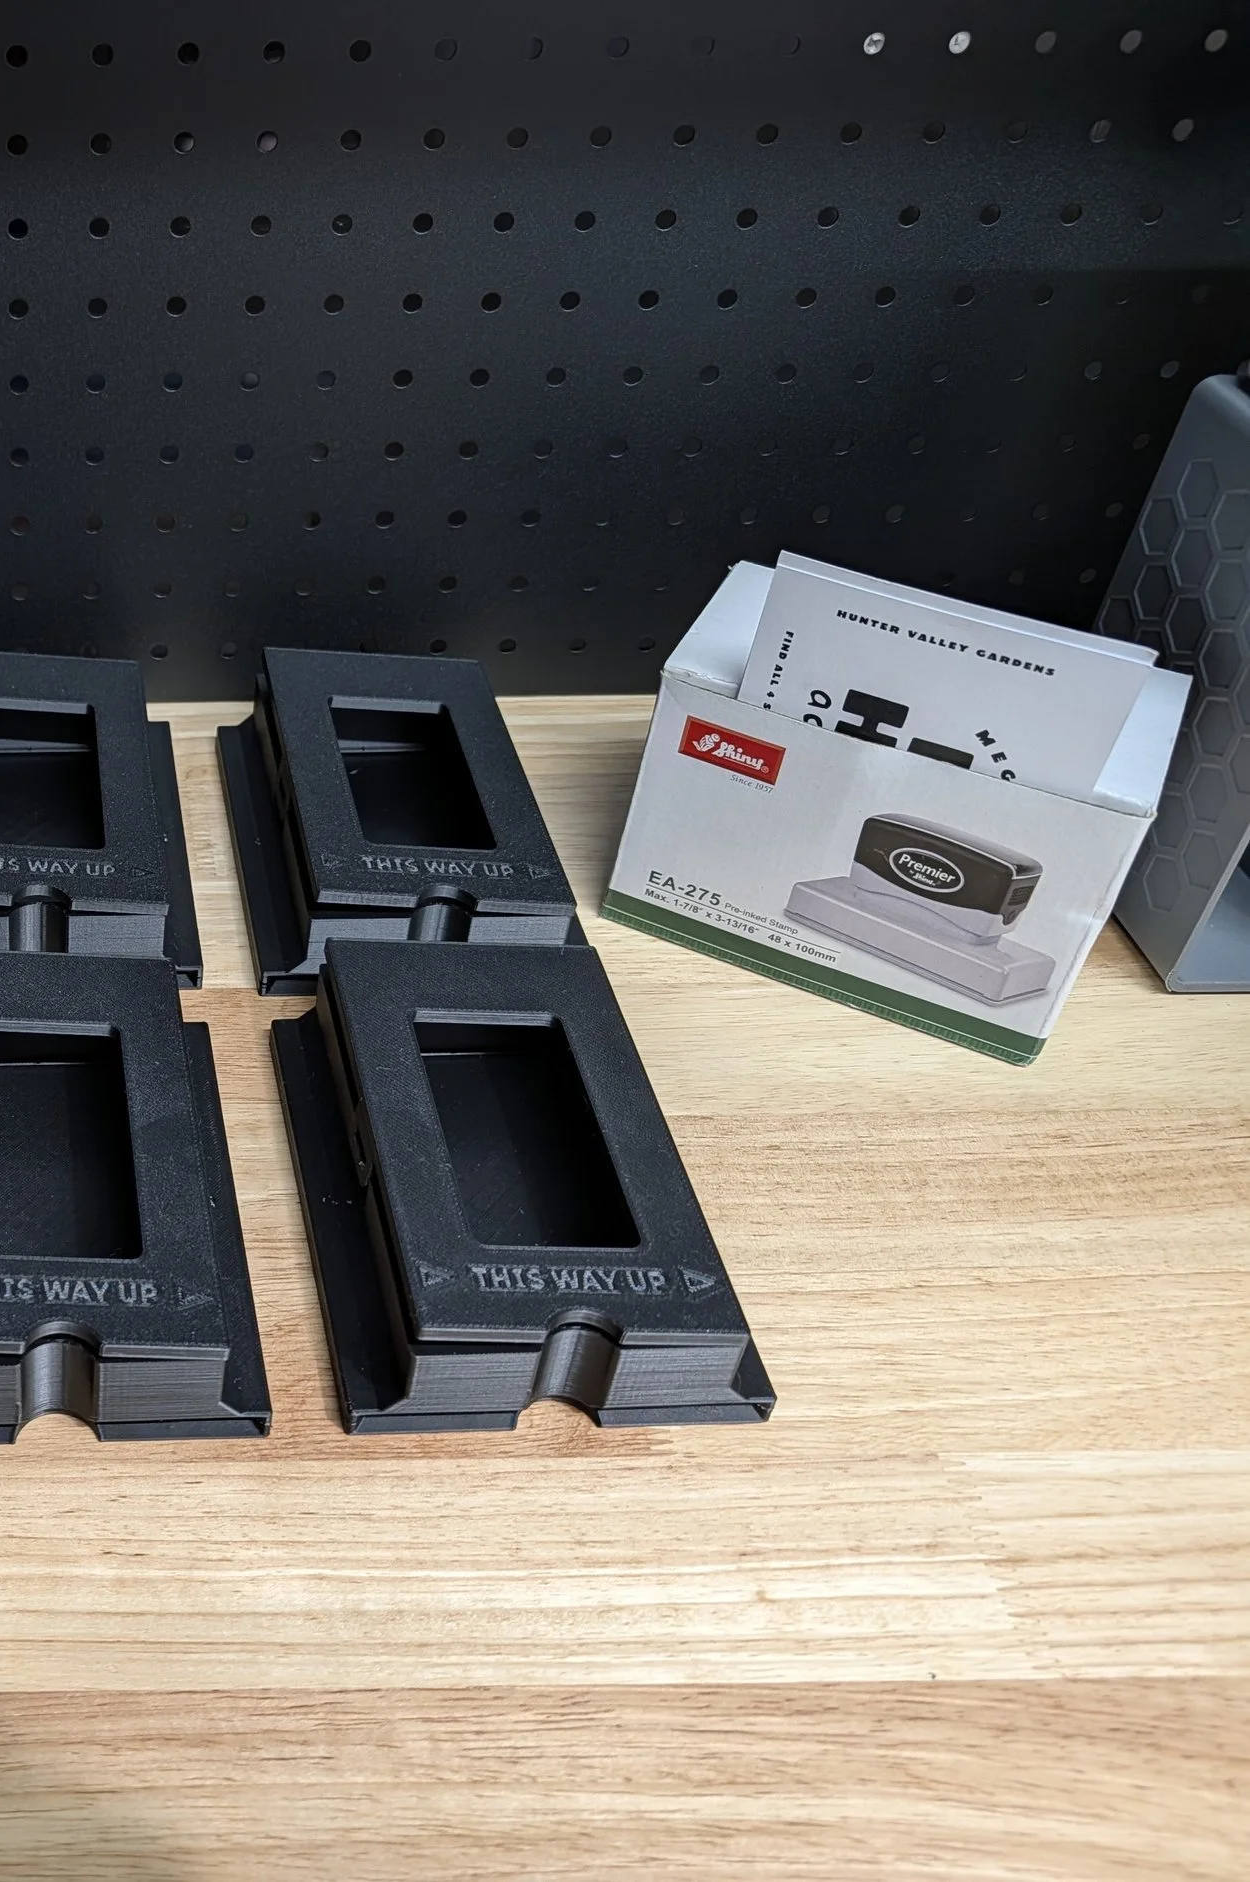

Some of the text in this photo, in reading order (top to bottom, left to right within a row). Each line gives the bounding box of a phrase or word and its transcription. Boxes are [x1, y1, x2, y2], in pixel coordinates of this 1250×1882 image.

[777, 630, 794, 660] FIND
[836, 609, 1056, 677] HUNTER VALLEY GARDENS
[769, 664, 784, 686] ALL
[766, 691, 775, 699] 4
[711, 741, 764, 771] Shiny
[730, 774, 774, 794] Since 1957
[27, 858, 78, 875] WAY
[85, 863, 115, 877] UP
[361, 854, 514, 878] THIS WAY UP
[898, 853, 956, 884] Premier
[648, 870, 799, 936] EA-275 Pre-inked Stamp
[644, 888, 669, 904] Max.
[705, 911, 712, 919] x
[767, 933, 782, 944] 48
[794, 943, 836, 963] 100mm
[42, 1278, 110, 1304] WAY
[118, 1281, 157, 1305] UP
[470, 1266, 666, 1295] THIS WAY UP
